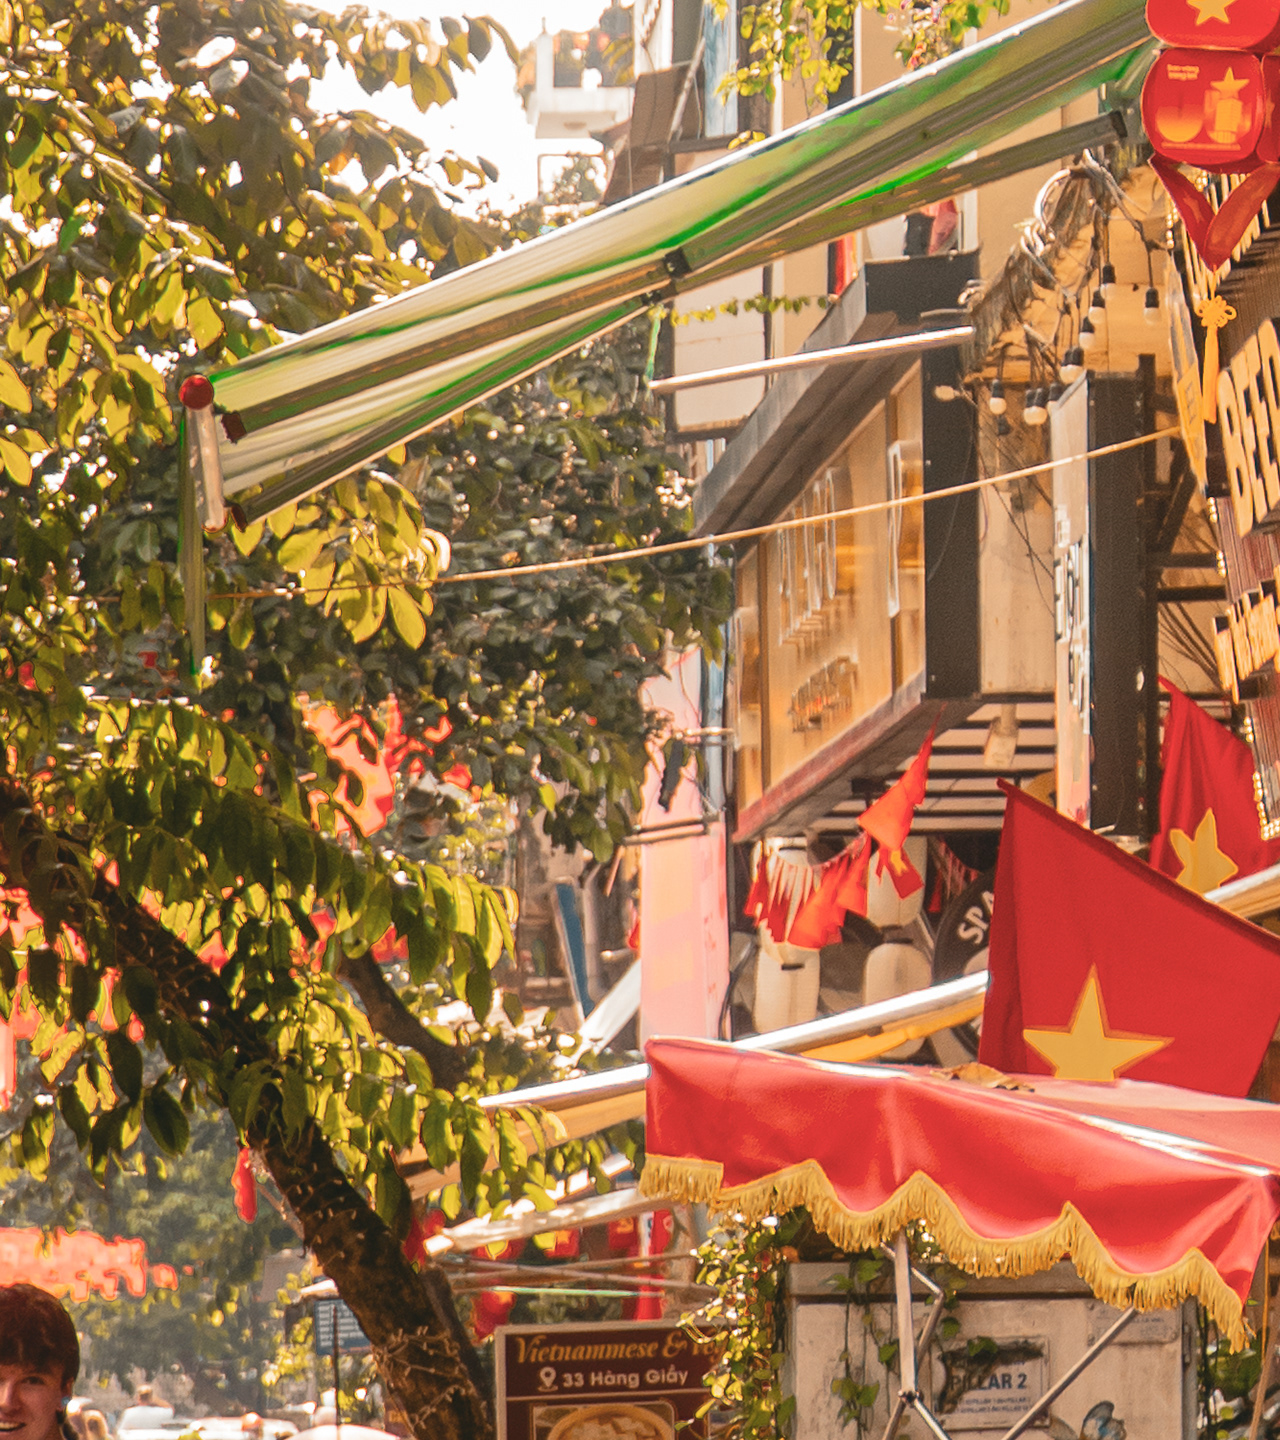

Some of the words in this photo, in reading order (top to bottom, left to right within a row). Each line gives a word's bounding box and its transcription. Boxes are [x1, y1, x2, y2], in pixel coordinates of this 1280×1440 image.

[516, 1334, 659, 1363] Vietnammese
[662, 1331, 687, 1358] &
[562, 1372, 584, 1388] 33
[1017, 1372, 1028, 1390] 2
